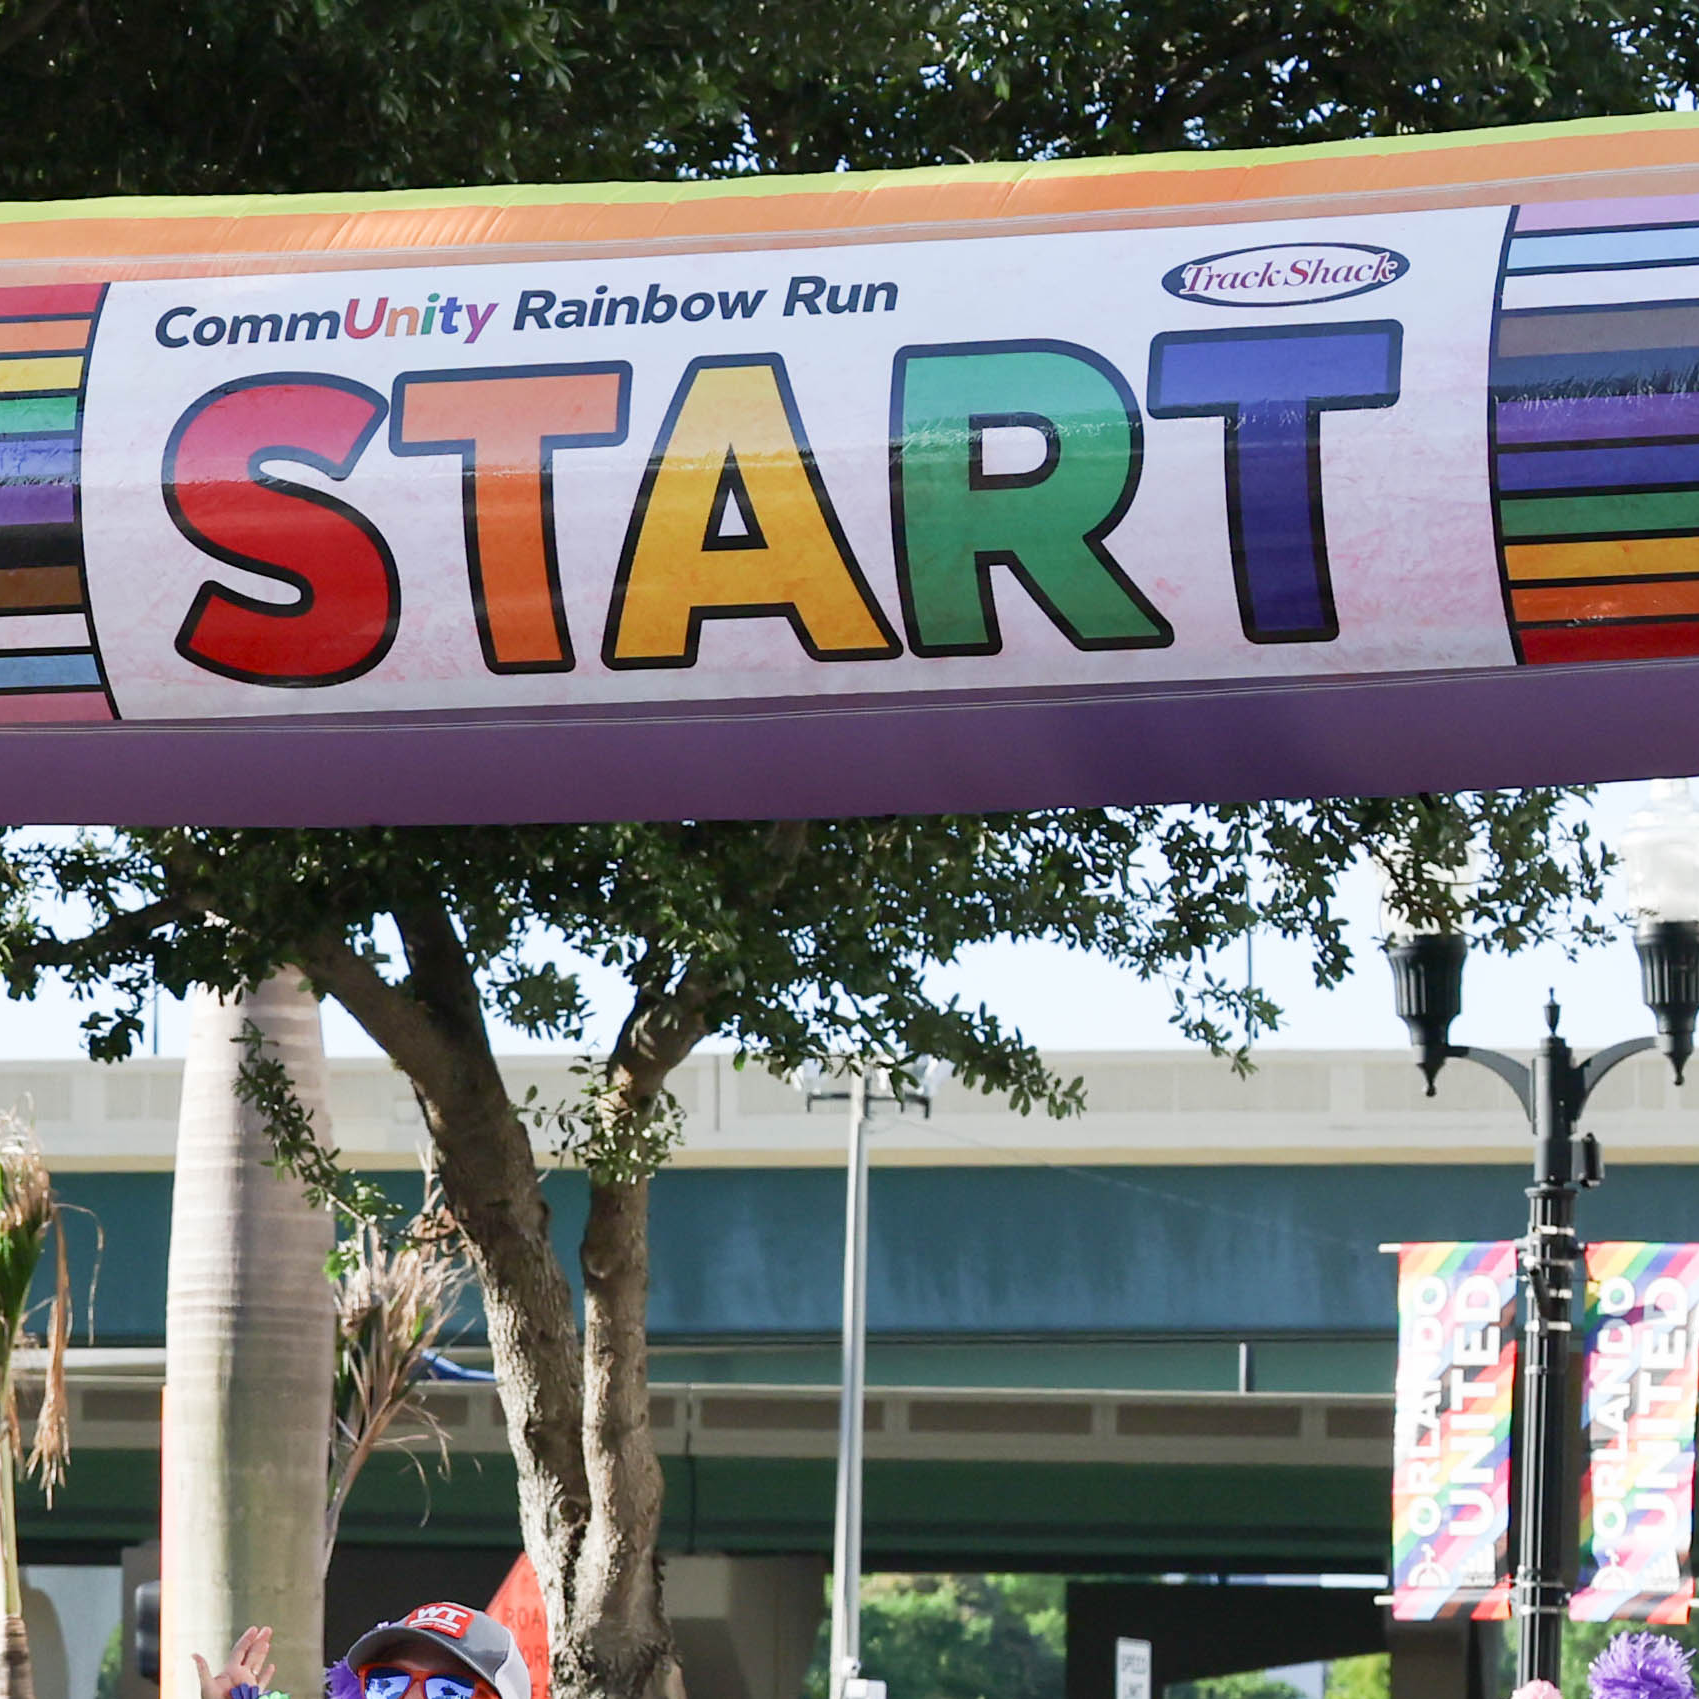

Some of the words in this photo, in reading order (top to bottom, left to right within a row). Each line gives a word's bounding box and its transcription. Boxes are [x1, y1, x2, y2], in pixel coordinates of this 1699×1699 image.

[154, 292, 498, 348] CommUnity
[512, 285, 766, 332] Rainbow
[782, 274, 900, 318] Run
[1180, 261, 1282, 293] Track
[1283, 254, 1398, 287] Shack
[161, 318, 1402, 689] START
[1405, 1274, 1448, 1537] ORLANDO
[1448, 1274, 1500, 1537] UNITED
[1591, 1275, 1635, 1537] ORLANDO
[1634, 1276, 1689, 1540] UNITED
[502, 1606, 547, 1631] ROA
